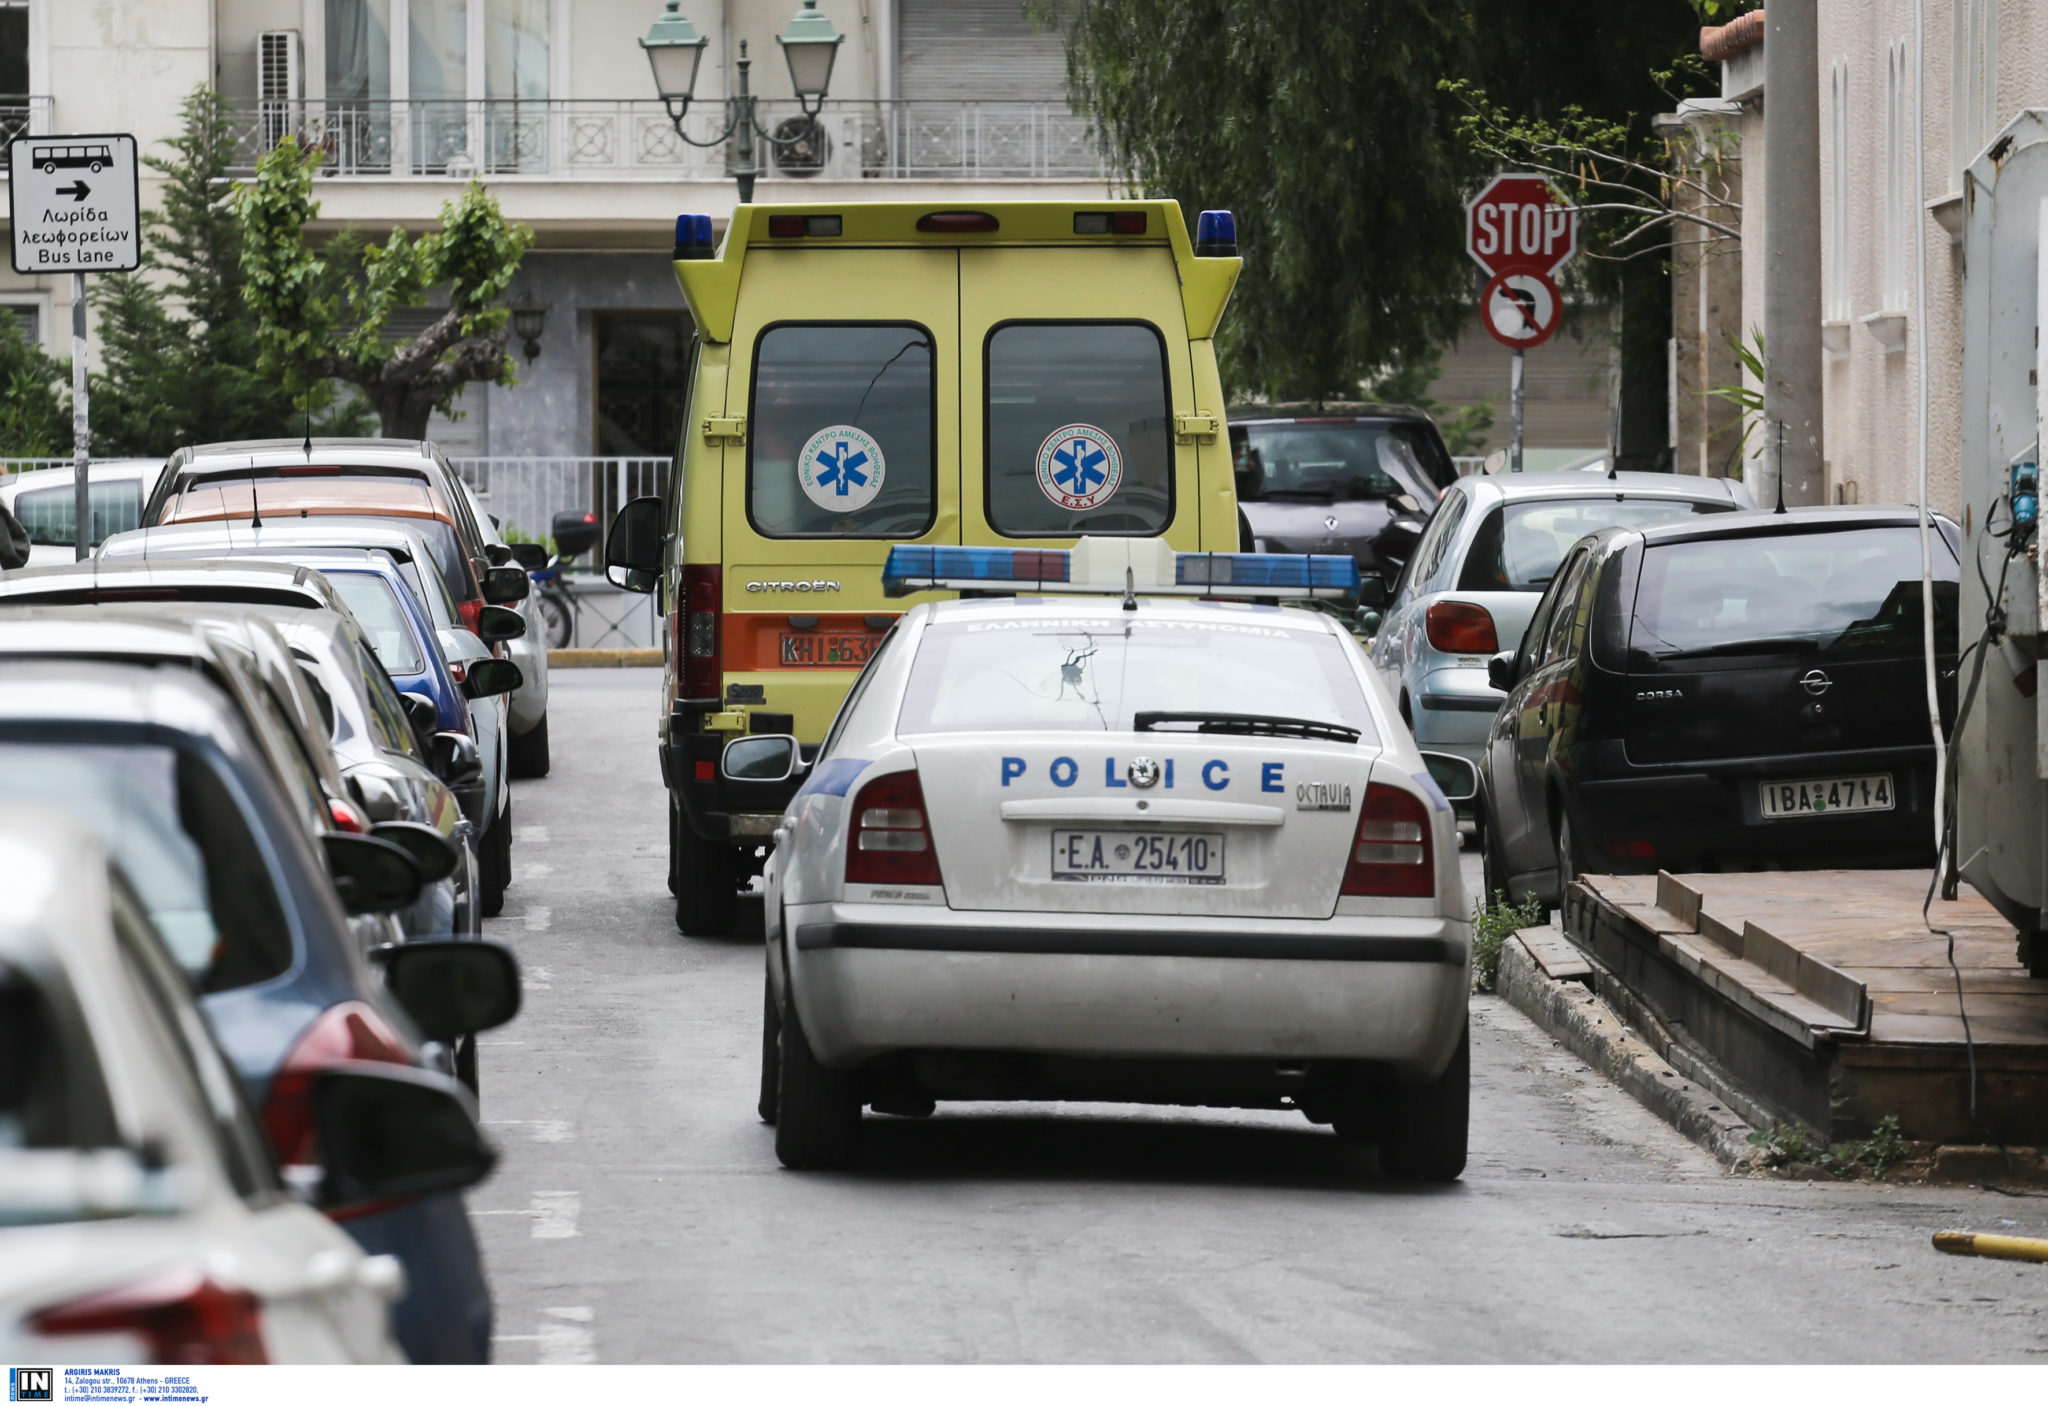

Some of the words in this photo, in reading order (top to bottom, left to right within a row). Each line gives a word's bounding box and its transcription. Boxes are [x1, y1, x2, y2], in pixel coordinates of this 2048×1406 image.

[42, 207, 108, 226] Λωρίδα
[22, 227, 129, 247] λεωφορείων
[1476, 202, 1567, 255] STOP
[38, 249, 71, 264] Bus
[77, 248, 114, 262] lane
[808, 431, 837, 454] ΚΕΝΤΡΟ
[839, 430, 871, 447] ΑΜΕΣΗΣ
[1047, 429, 1074, 451] ΚΕΝΤΡΟ
[745, 580, 841, 592] CITROËN
[967, 619, 1110, 633] ΕΛΛΗΝΙΚΗ
[1128, 619, 1291, 639] ΑΣΤΥΝΟΜΙΑ
[1636, 689, 1684, 701] CORSA
[1001, 756, 1285, 793] POLICE
[1296, 780, 1351, 803] OCTAVIA
[1133, 835, 1208, 871] 25410
